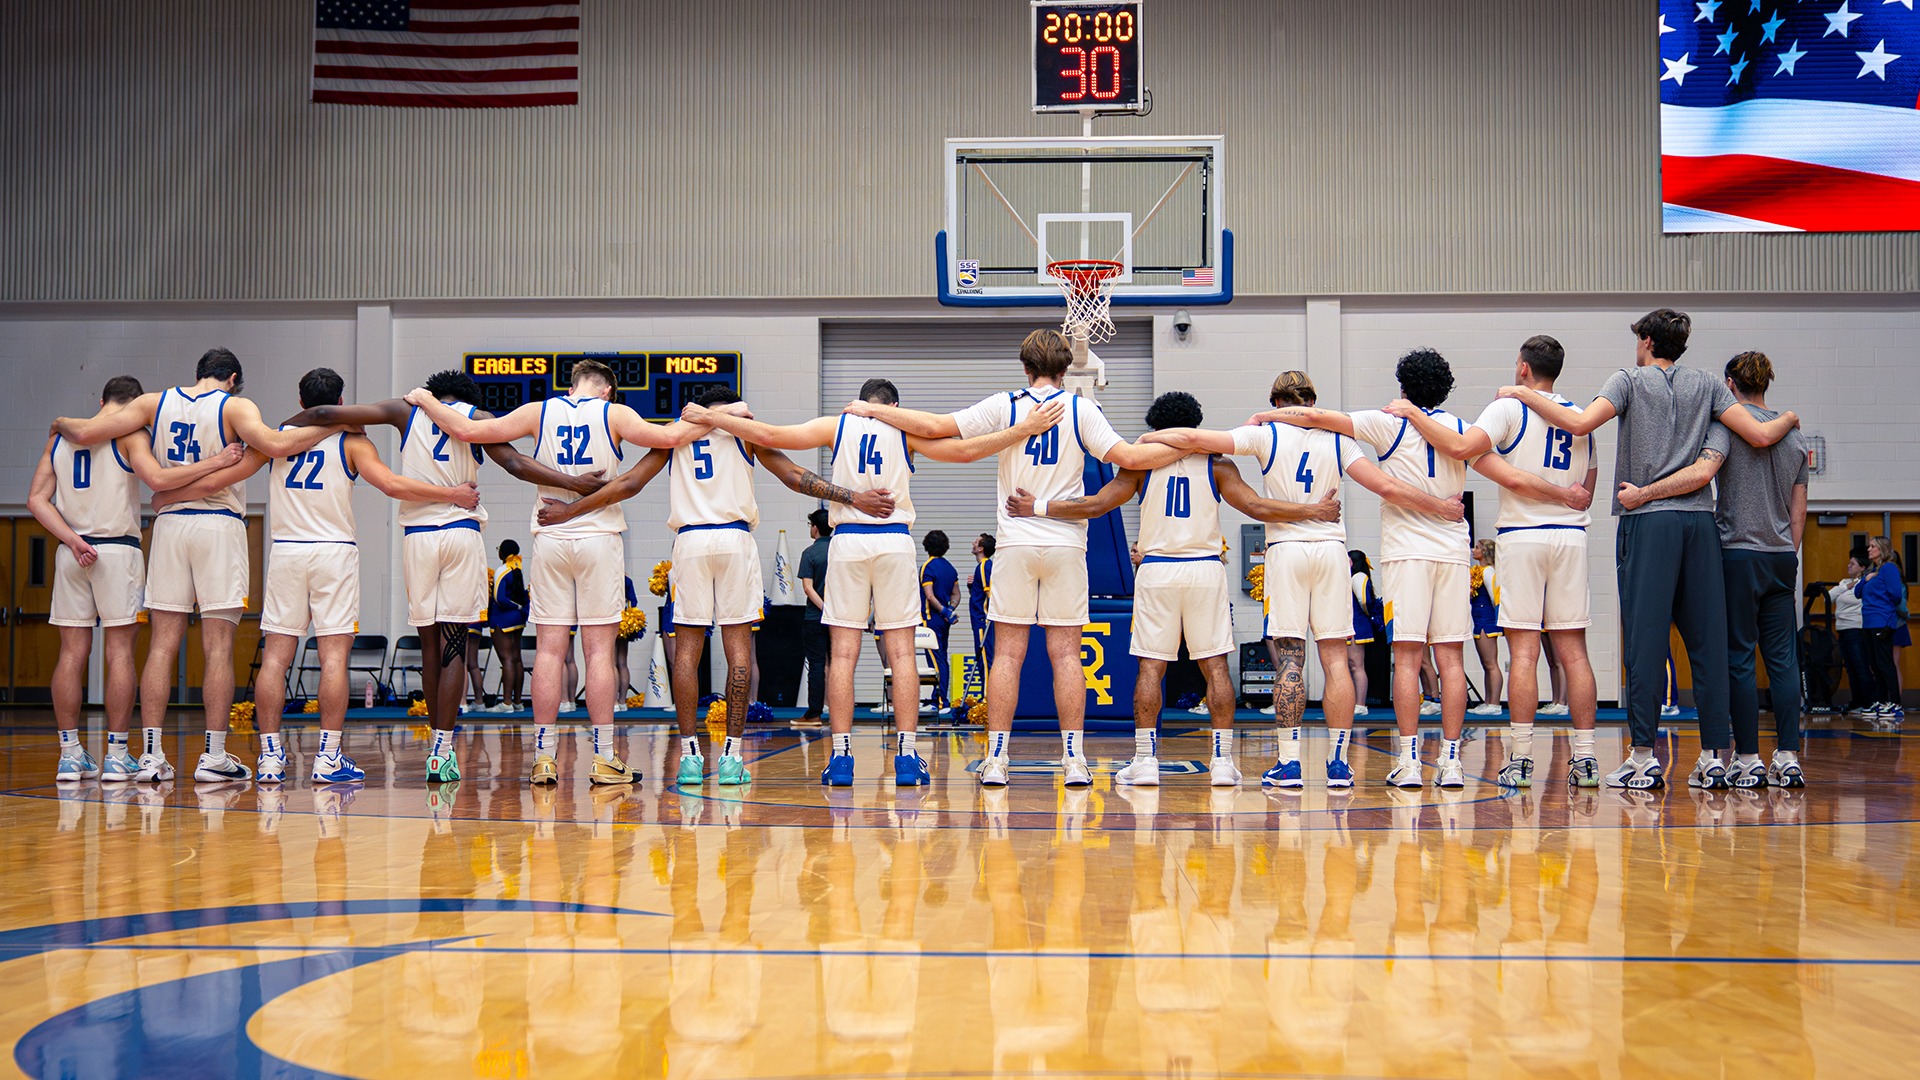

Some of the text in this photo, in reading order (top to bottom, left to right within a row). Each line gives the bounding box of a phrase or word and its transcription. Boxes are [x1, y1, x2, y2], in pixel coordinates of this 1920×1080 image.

[1043, 12, 1133, 44] 20:00
[1060, 46, 1120, 99] 30
[473, 357, 547, 375] EAGLES
[666, 356, 718, 374] MOCS
[167, 421, 201, 463] 34
[431, 423, 450, 462] 2
[556, 424, 593, 466] 32
[692, 440, 714, 480] 5
[858, 433, 883, 475] 14
[1024, 425, 1059, 466] 40
[1427, 443, 1435, 478] 1
[1543, 426, 1573, 471] 13
[73, 449, 91, 489] 0
[285, 449, 324, 490] 22
[1295, 451, 1314, 493] 4
[1165, 475, 1191, 518] 10
